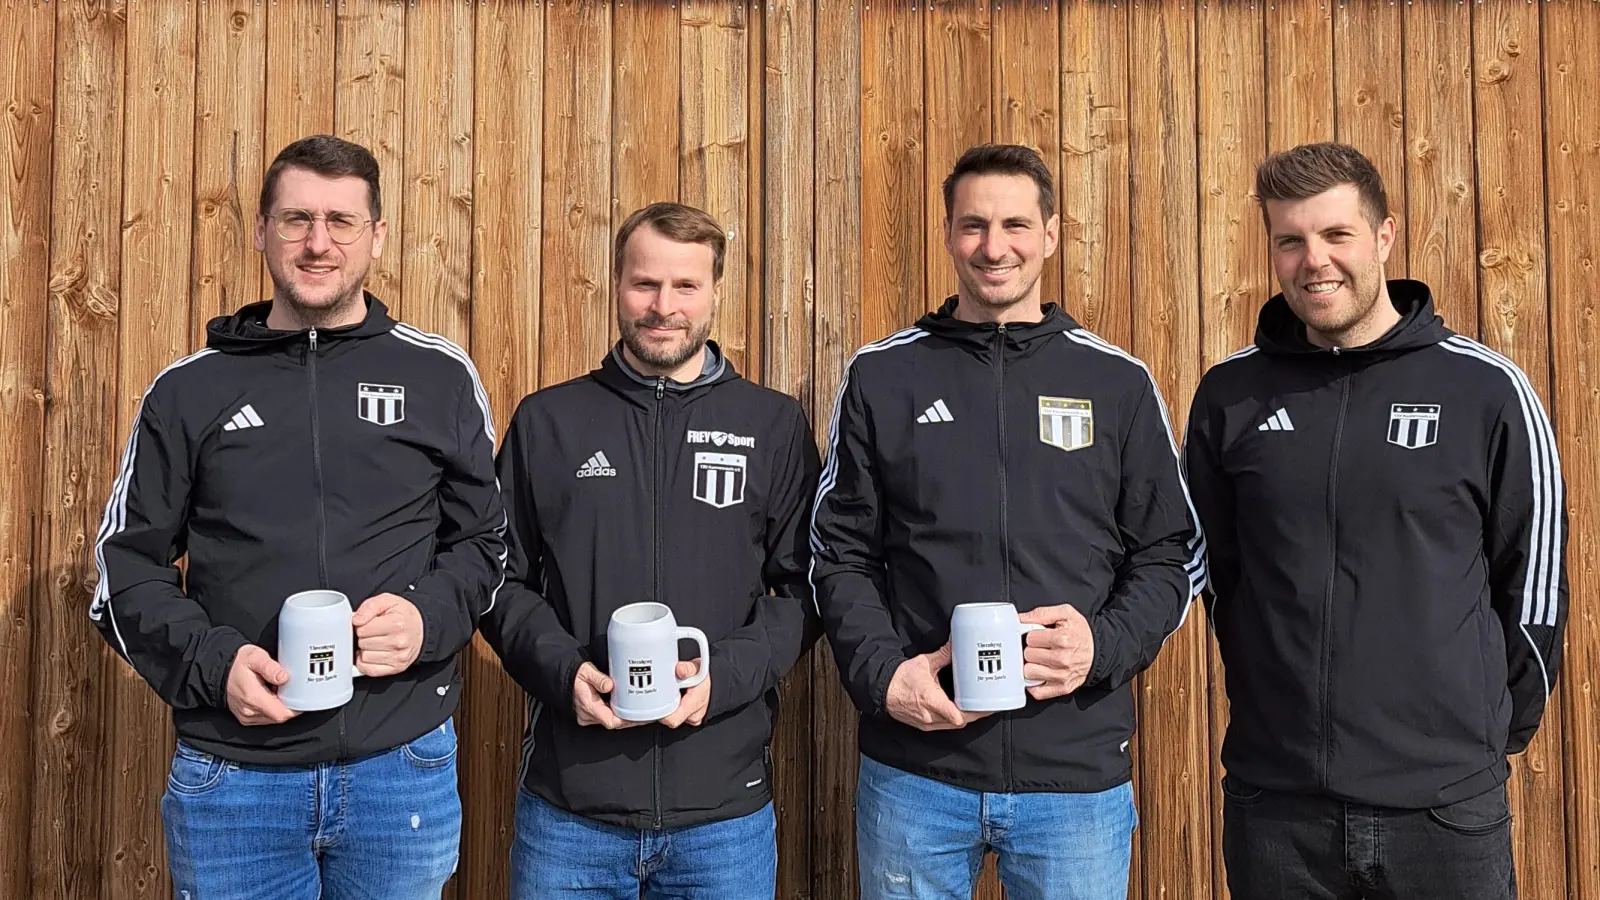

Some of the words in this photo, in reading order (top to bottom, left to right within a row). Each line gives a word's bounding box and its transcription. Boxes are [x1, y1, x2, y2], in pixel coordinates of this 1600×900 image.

[687, 430, 711, 443] FREY
[727, 433, 756, 449] Sport
[576, 467, 617, 478] adidas
